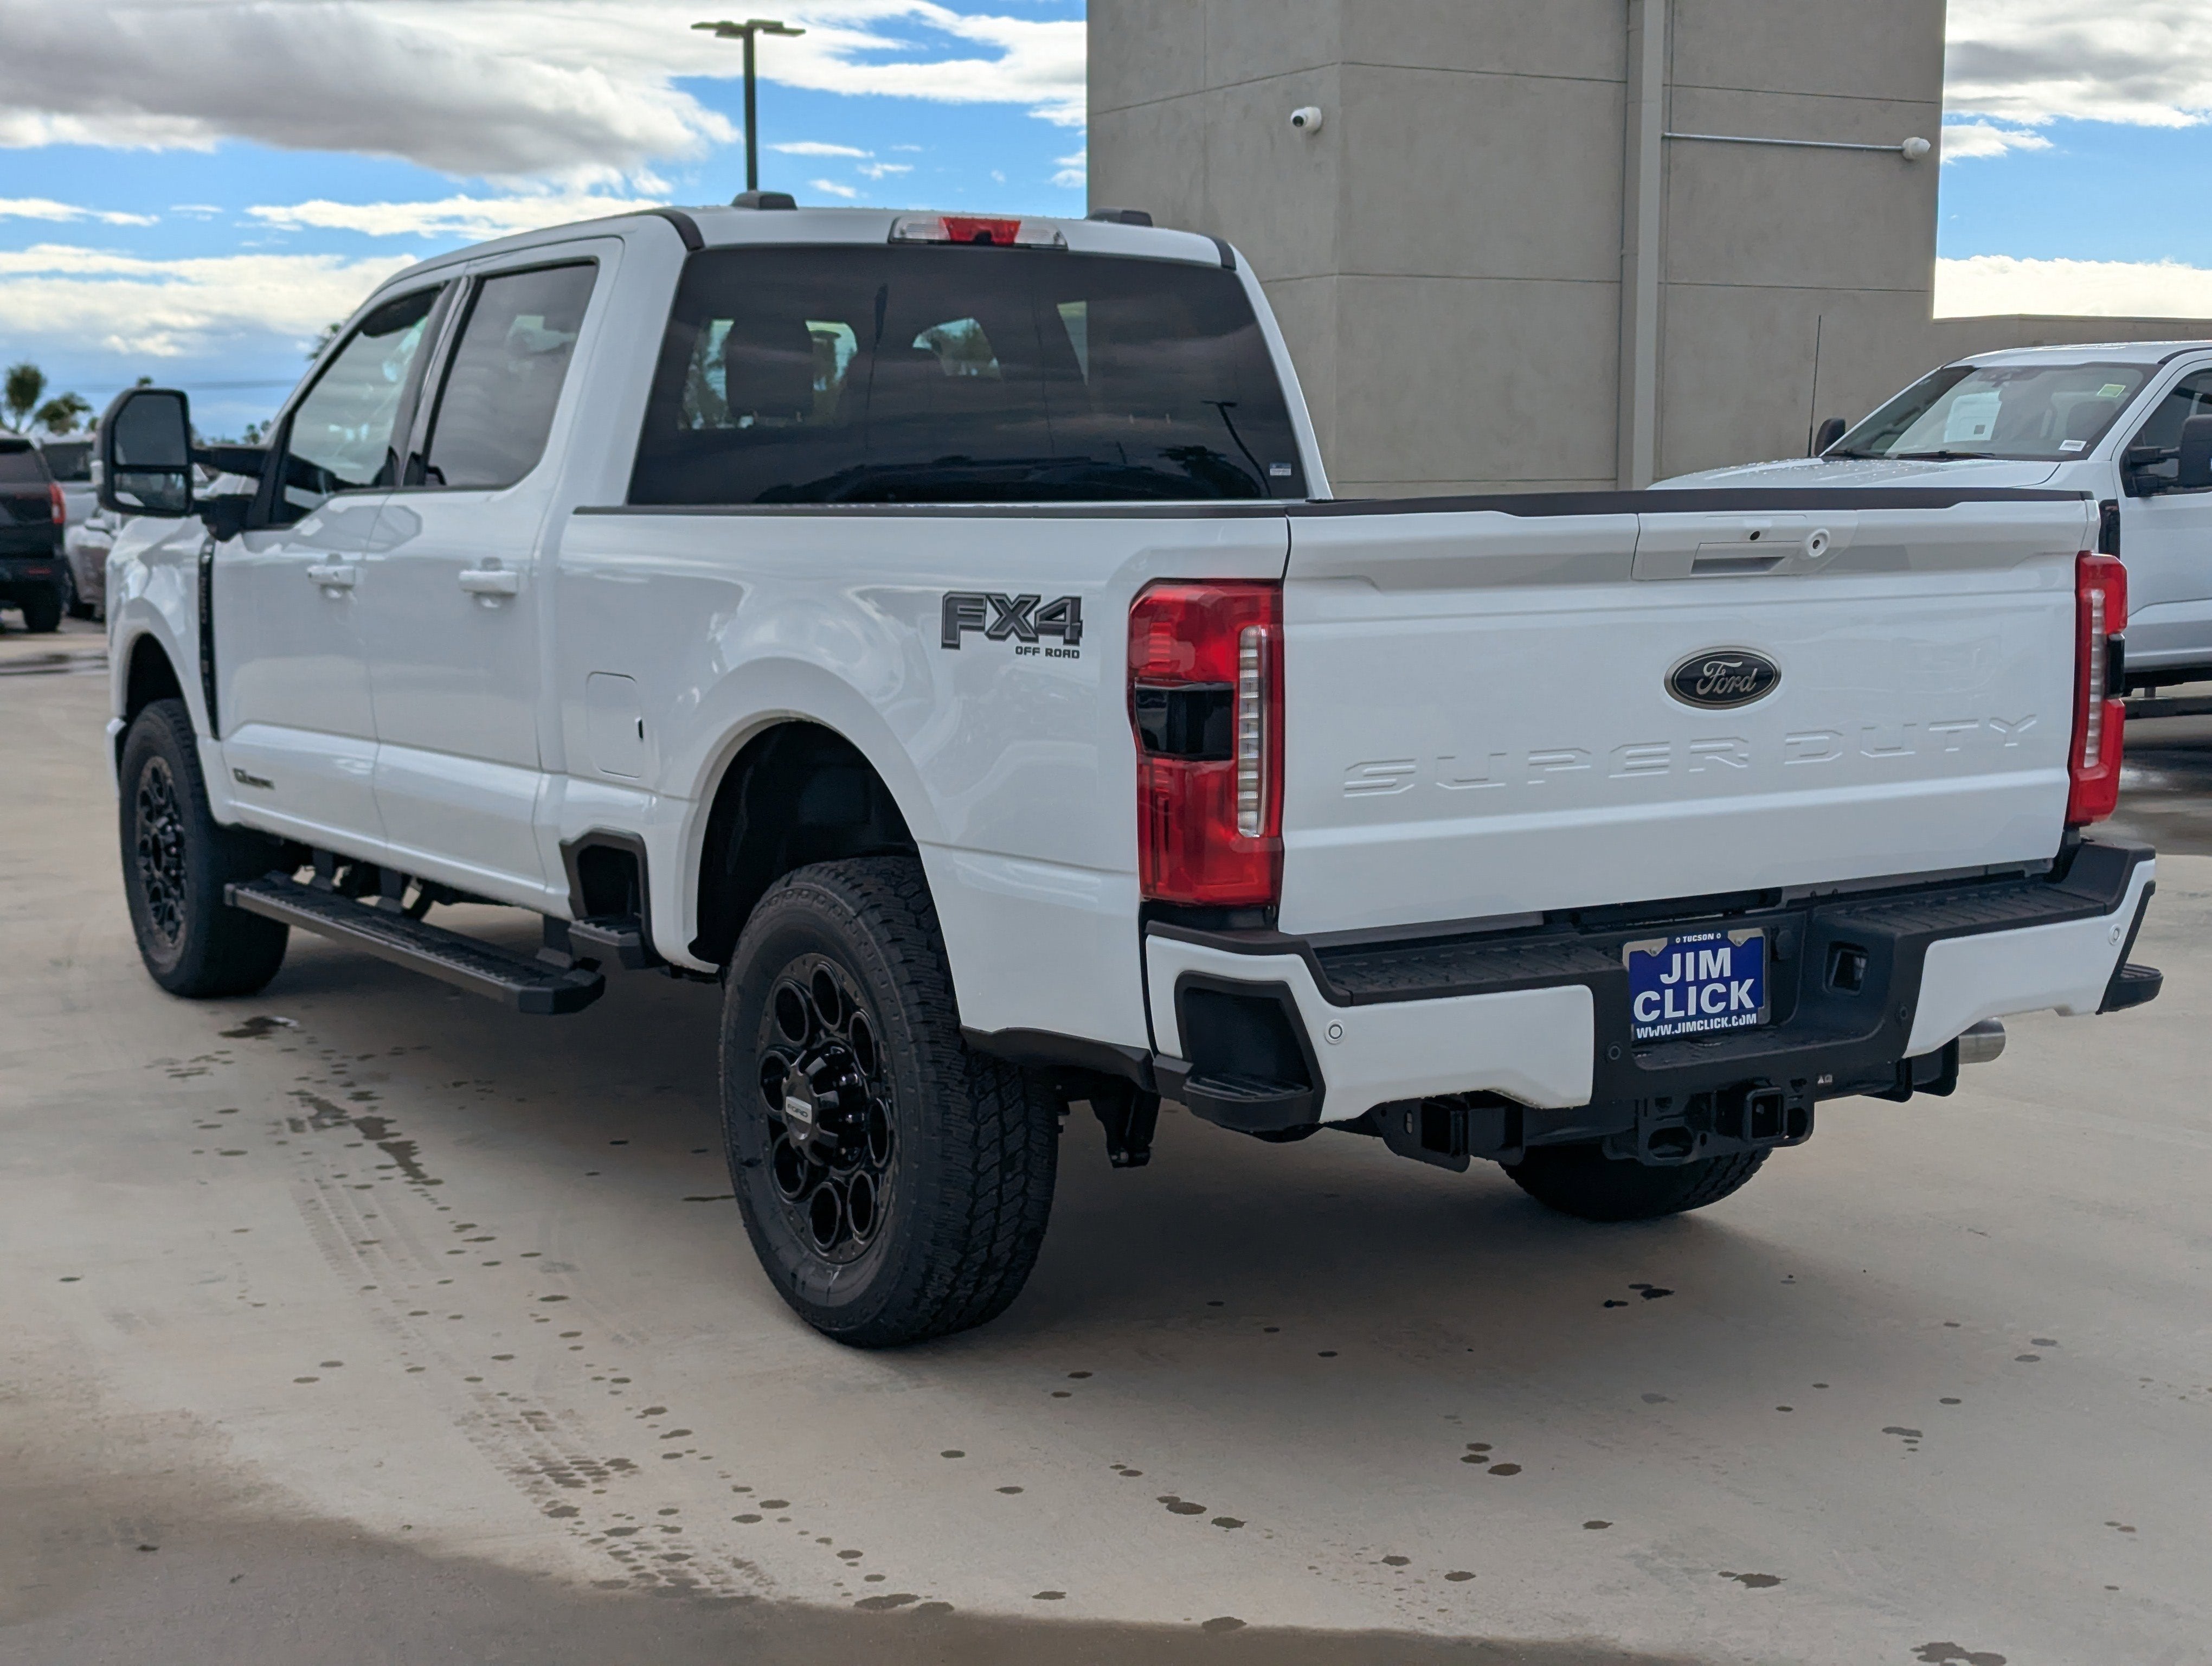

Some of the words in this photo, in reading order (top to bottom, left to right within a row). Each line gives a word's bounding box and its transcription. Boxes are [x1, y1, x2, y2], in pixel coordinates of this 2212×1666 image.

[941, 591, 1083, 650] FX4
[1015, 645, 1040, 656] OFF
[1045, 648, 1080, 659] ROAD
[1696, 661, 1758, 695] Ford
[1343, 737, 1749, 798] SUPER
[1784, 714, 2037, 765] DUTY
[1683, 933, 1714, 943] TUCSON
[1660, 947, 1731, 984] JIM
[1634, 978, 1754, 1022] CLICK
[1636, 1013, 1757, 1039] WWW.JIMCLICK.COM
